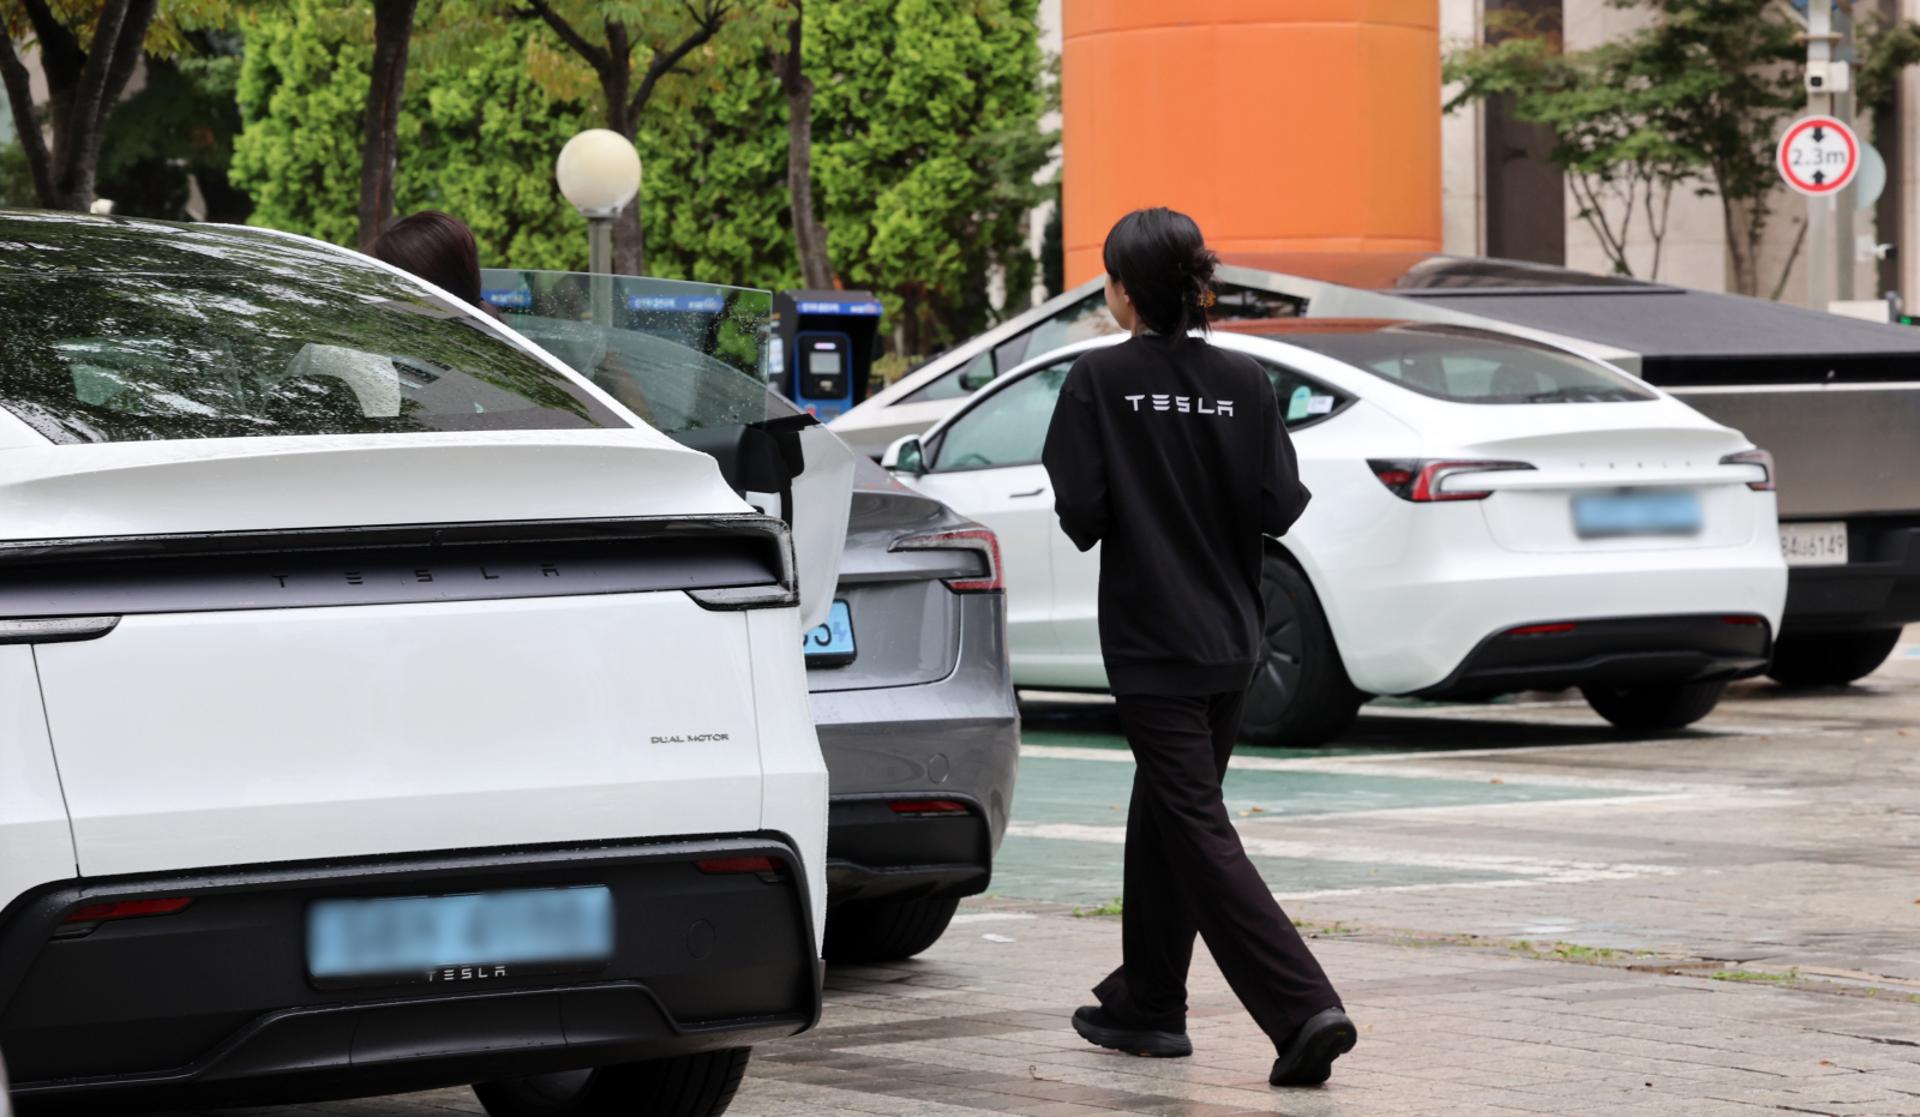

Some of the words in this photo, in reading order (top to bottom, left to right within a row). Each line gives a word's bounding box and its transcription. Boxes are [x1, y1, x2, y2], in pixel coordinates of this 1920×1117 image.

[1792, 148, 1846, 165] 2.3m
[1124, 394, 1234, 417] TESLA
[271, 562, 561, 589] TESLA
[651, 735, 685, 744] DUAL
[687, 733, 729, 742] MOTOR
[426, 965, 507, 982] TESLA
